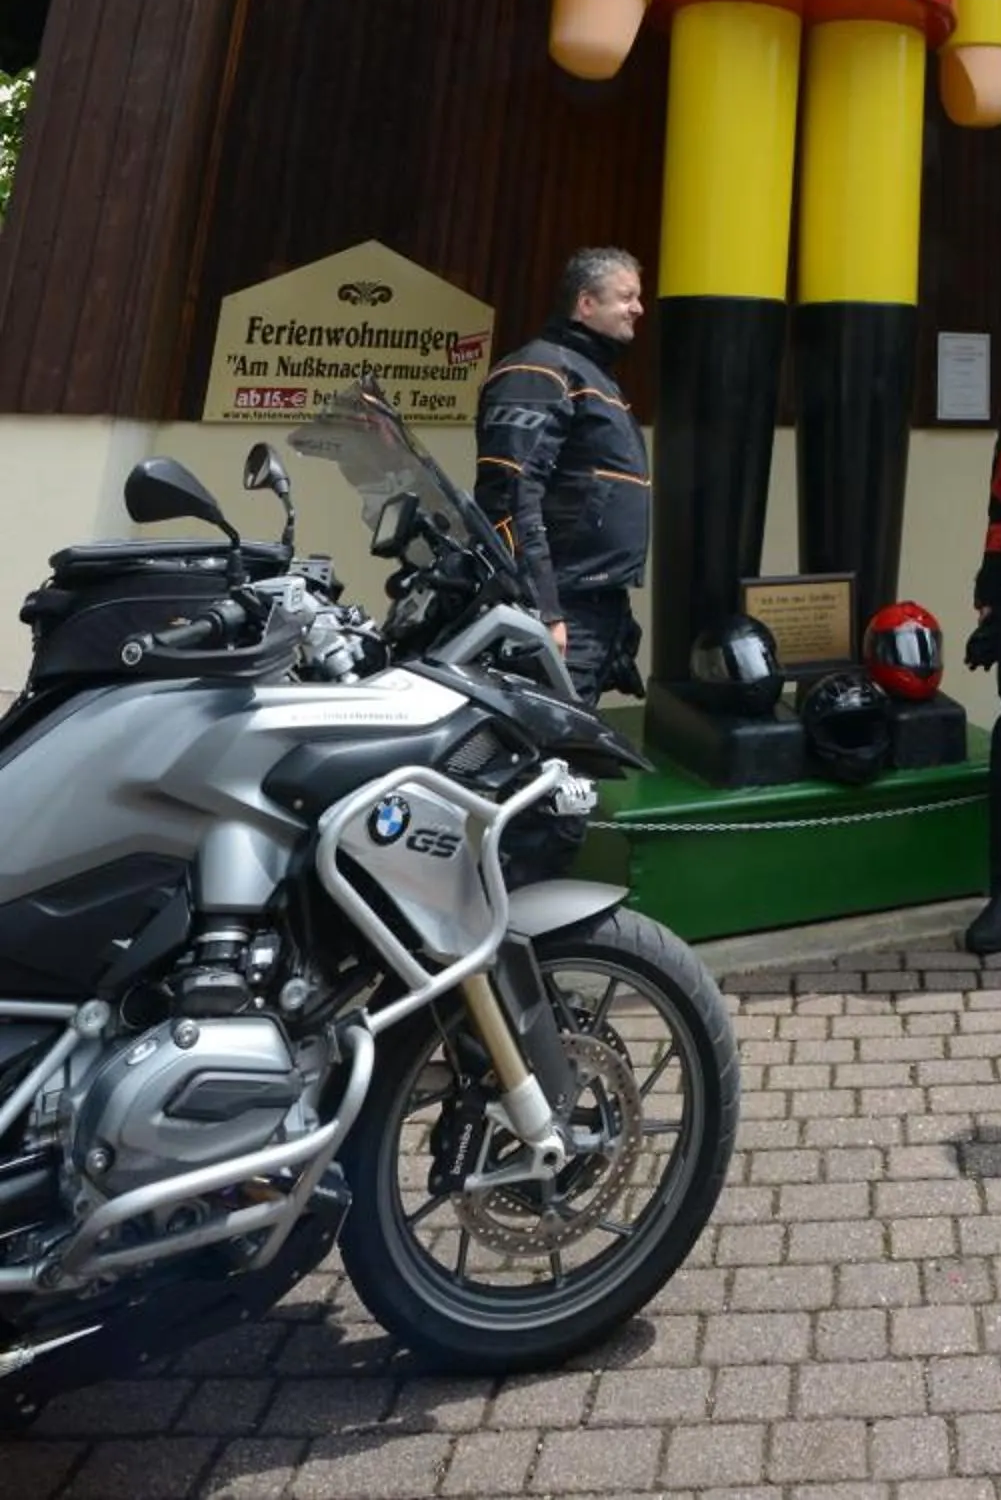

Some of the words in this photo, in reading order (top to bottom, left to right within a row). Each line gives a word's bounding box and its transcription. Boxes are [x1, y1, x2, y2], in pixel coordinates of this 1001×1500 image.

[245, 315, 459, 356] Ferienwohnungen
[410, 390, 457, 410] Tagen
[406, 828, 462, 858] GS
[449, 1123, 473, 1175] brembo
